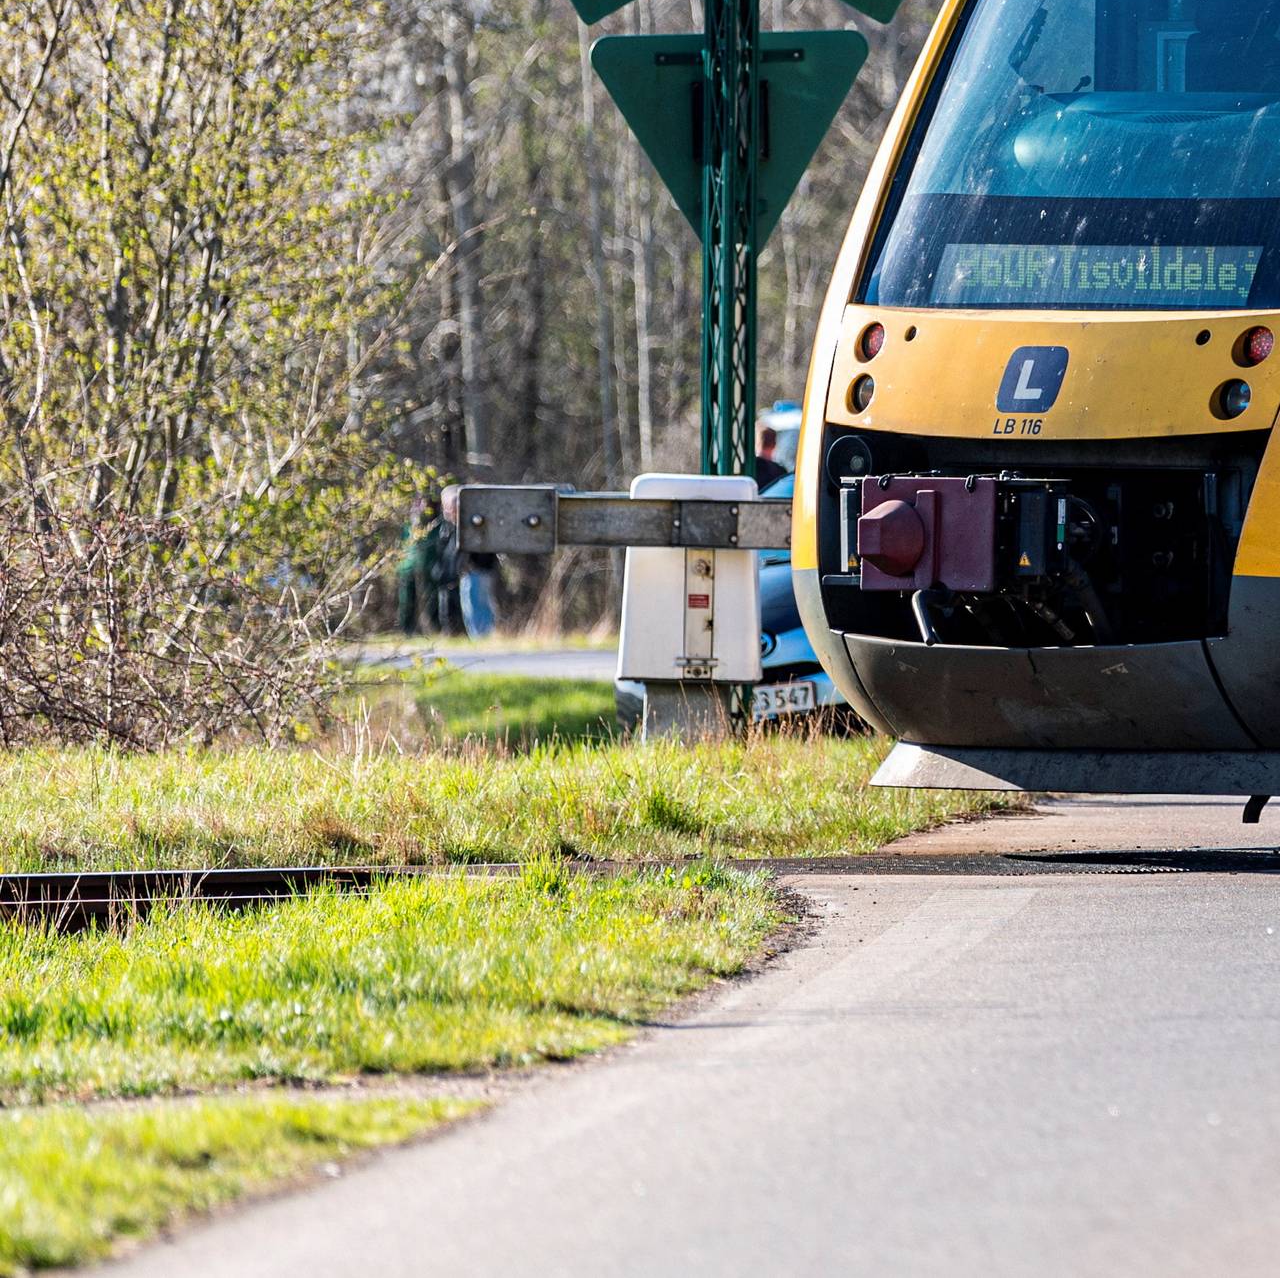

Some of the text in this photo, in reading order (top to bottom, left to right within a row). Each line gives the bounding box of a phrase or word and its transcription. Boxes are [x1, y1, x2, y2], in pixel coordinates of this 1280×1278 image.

[1013, 360, 1042, 399] L
[993, 418, 1043, 435] LB 116
